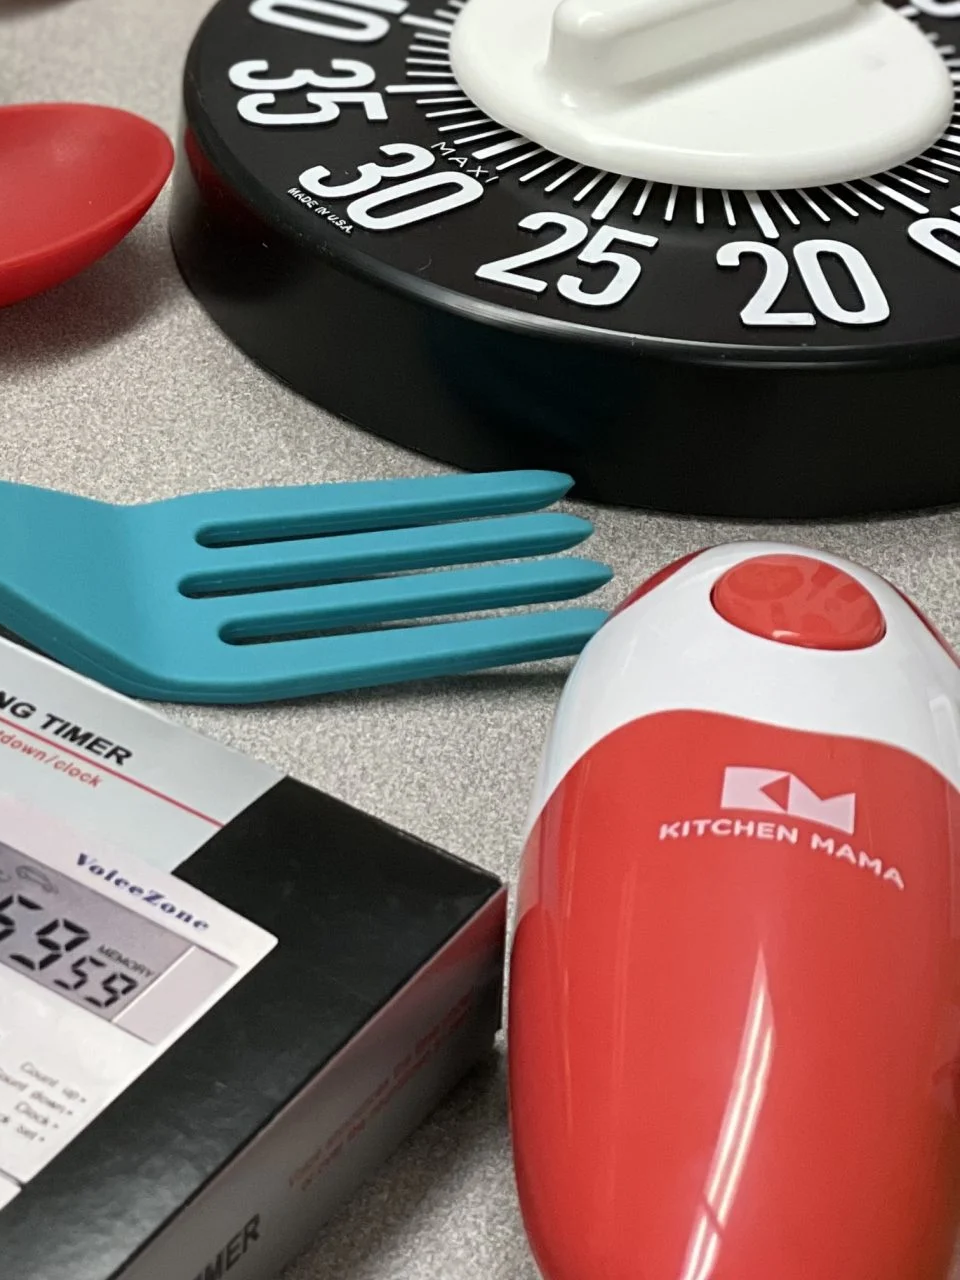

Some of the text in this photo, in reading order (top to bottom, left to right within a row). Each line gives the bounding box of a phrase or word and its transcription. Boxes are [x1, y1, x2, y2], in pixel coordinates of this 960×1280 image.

[228, 58, 389, 126] 35
[287, 187, 319, 208] MADE
[314, 206, 331, 216] IN
[298, 143, 484, 230] 30
[475, 212, 659, 307] 25
[716, 239, 890, 325] 20
[40, 713, 133, 765] TIMER
[658, 818, 905, 891] KITCHEN MAMA
[96, 943, 156, 979] MEMORY
[193, 1213, 260, 1280] MER
